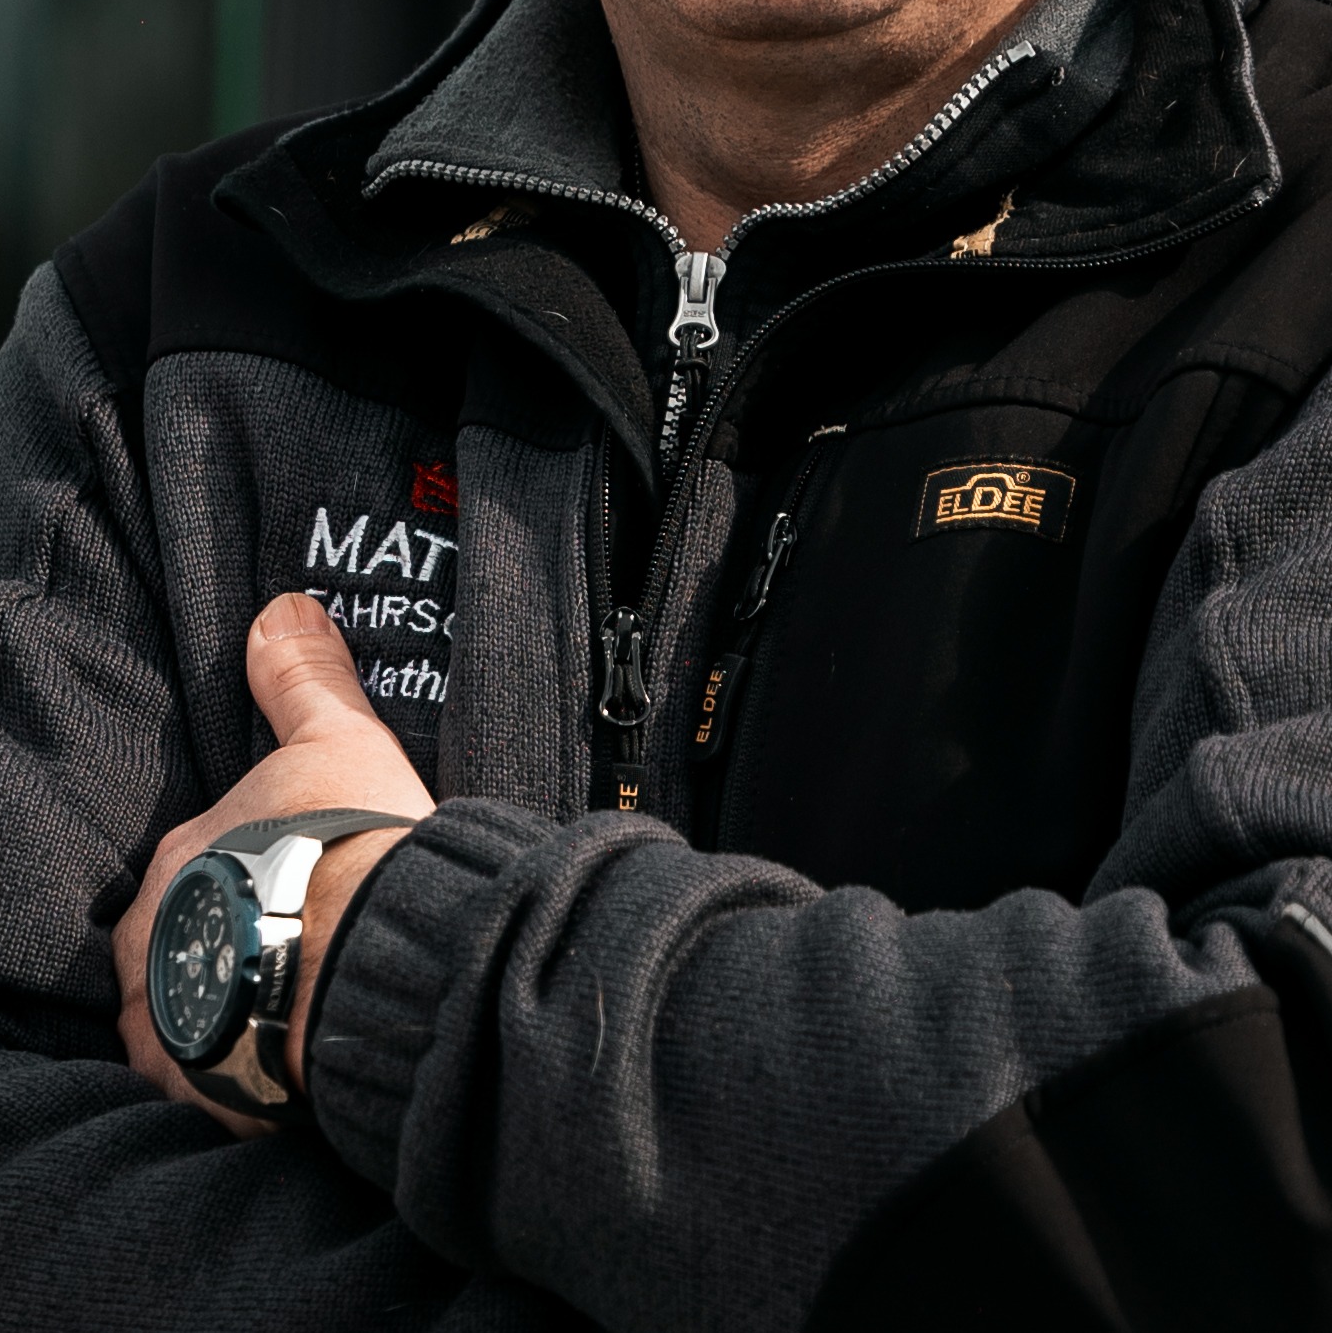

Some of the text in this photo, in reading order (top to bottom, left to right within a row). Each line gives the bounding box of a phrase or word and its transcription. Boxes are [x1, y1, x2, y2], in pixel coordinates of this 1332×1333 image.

[937, 486, 1045, 517] ELDEE
[306, 507, 459, 582] MAT
[305, 588, 456, 641] AHRS
